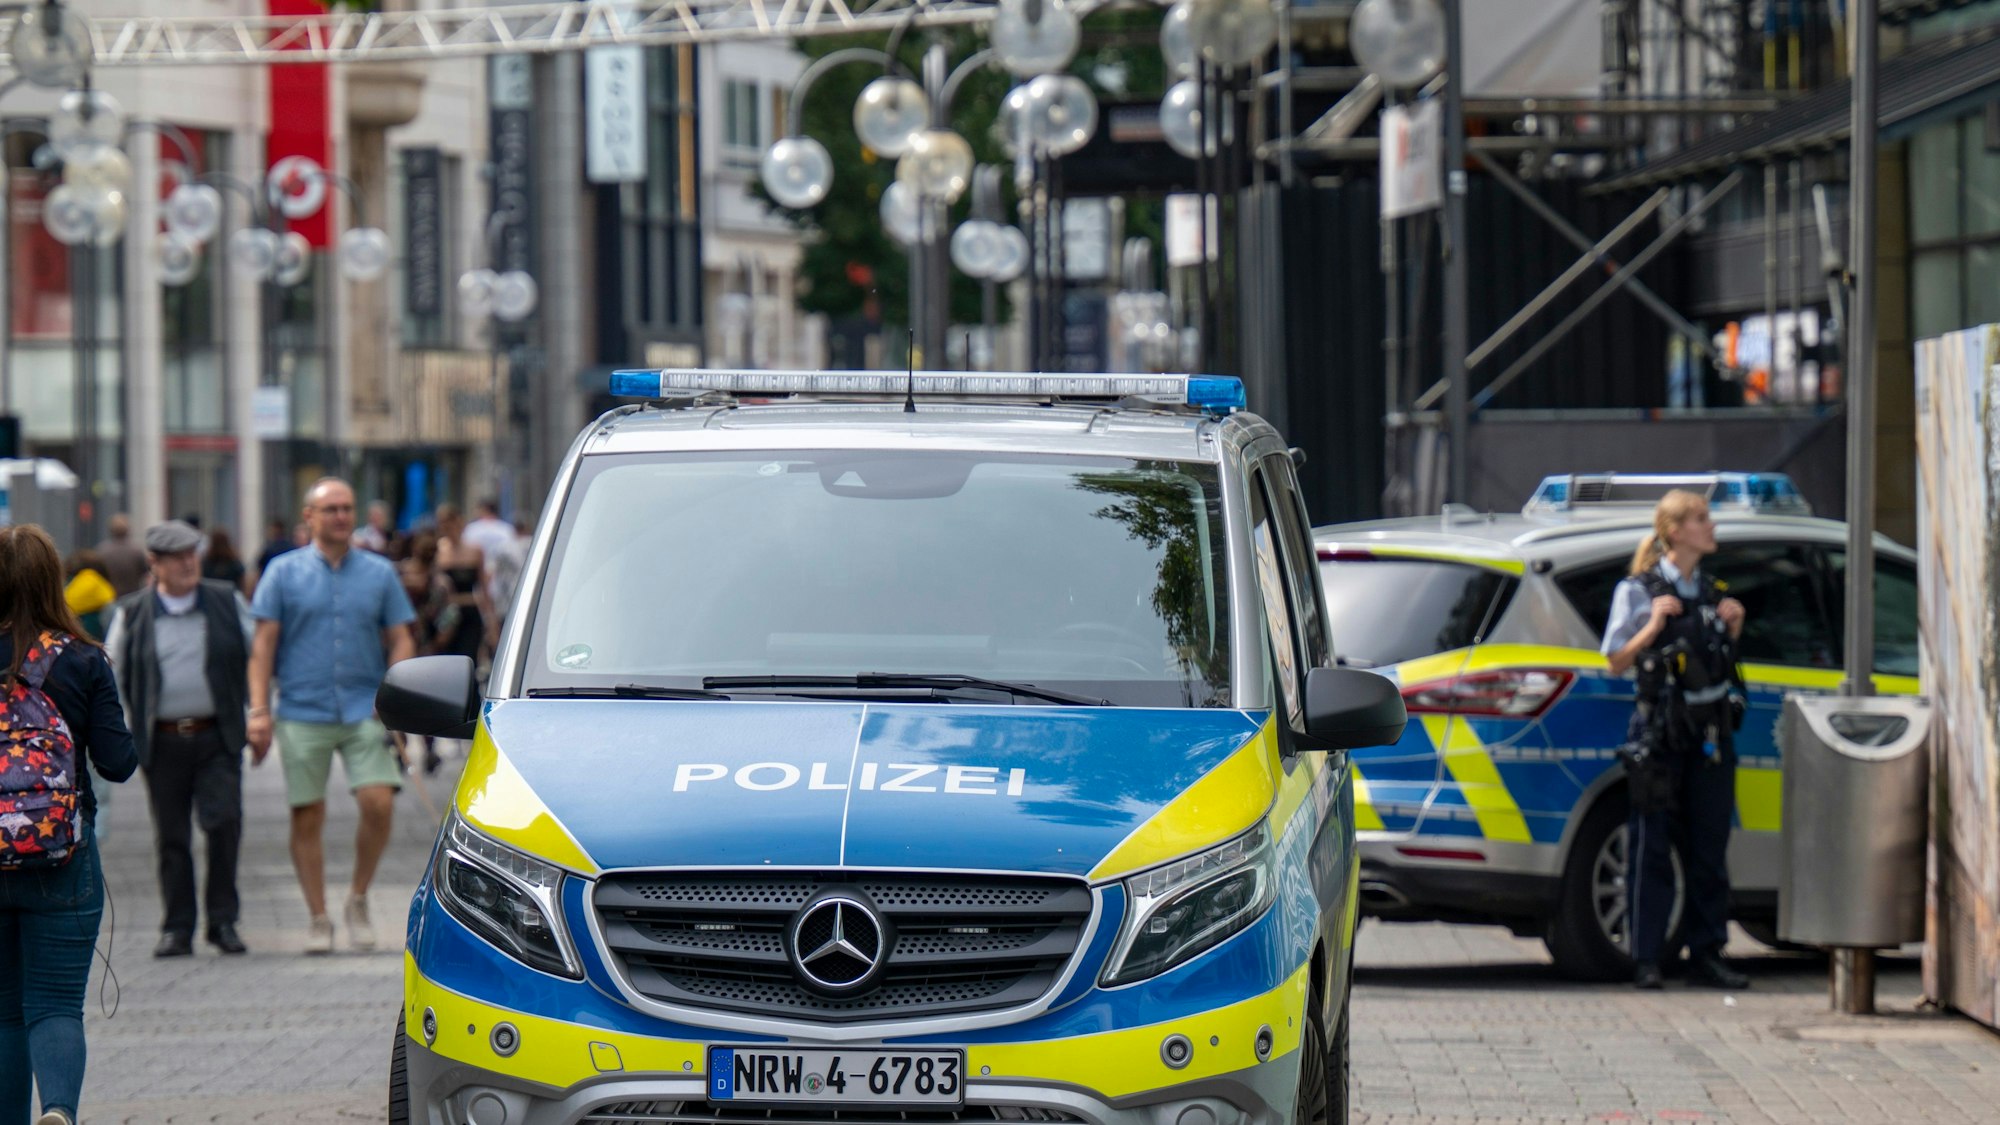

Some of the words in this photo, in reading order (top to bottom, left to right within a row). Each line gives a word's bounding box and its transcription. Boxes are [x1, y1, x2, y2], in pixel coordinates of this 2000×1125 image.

[672, 761, 1026, 797] POLIZEI
[717, 1078, 727, 1090] D
[734, 1054, 803, 1093] NRW
[826, 1056, 958, 1095] 4-6783
